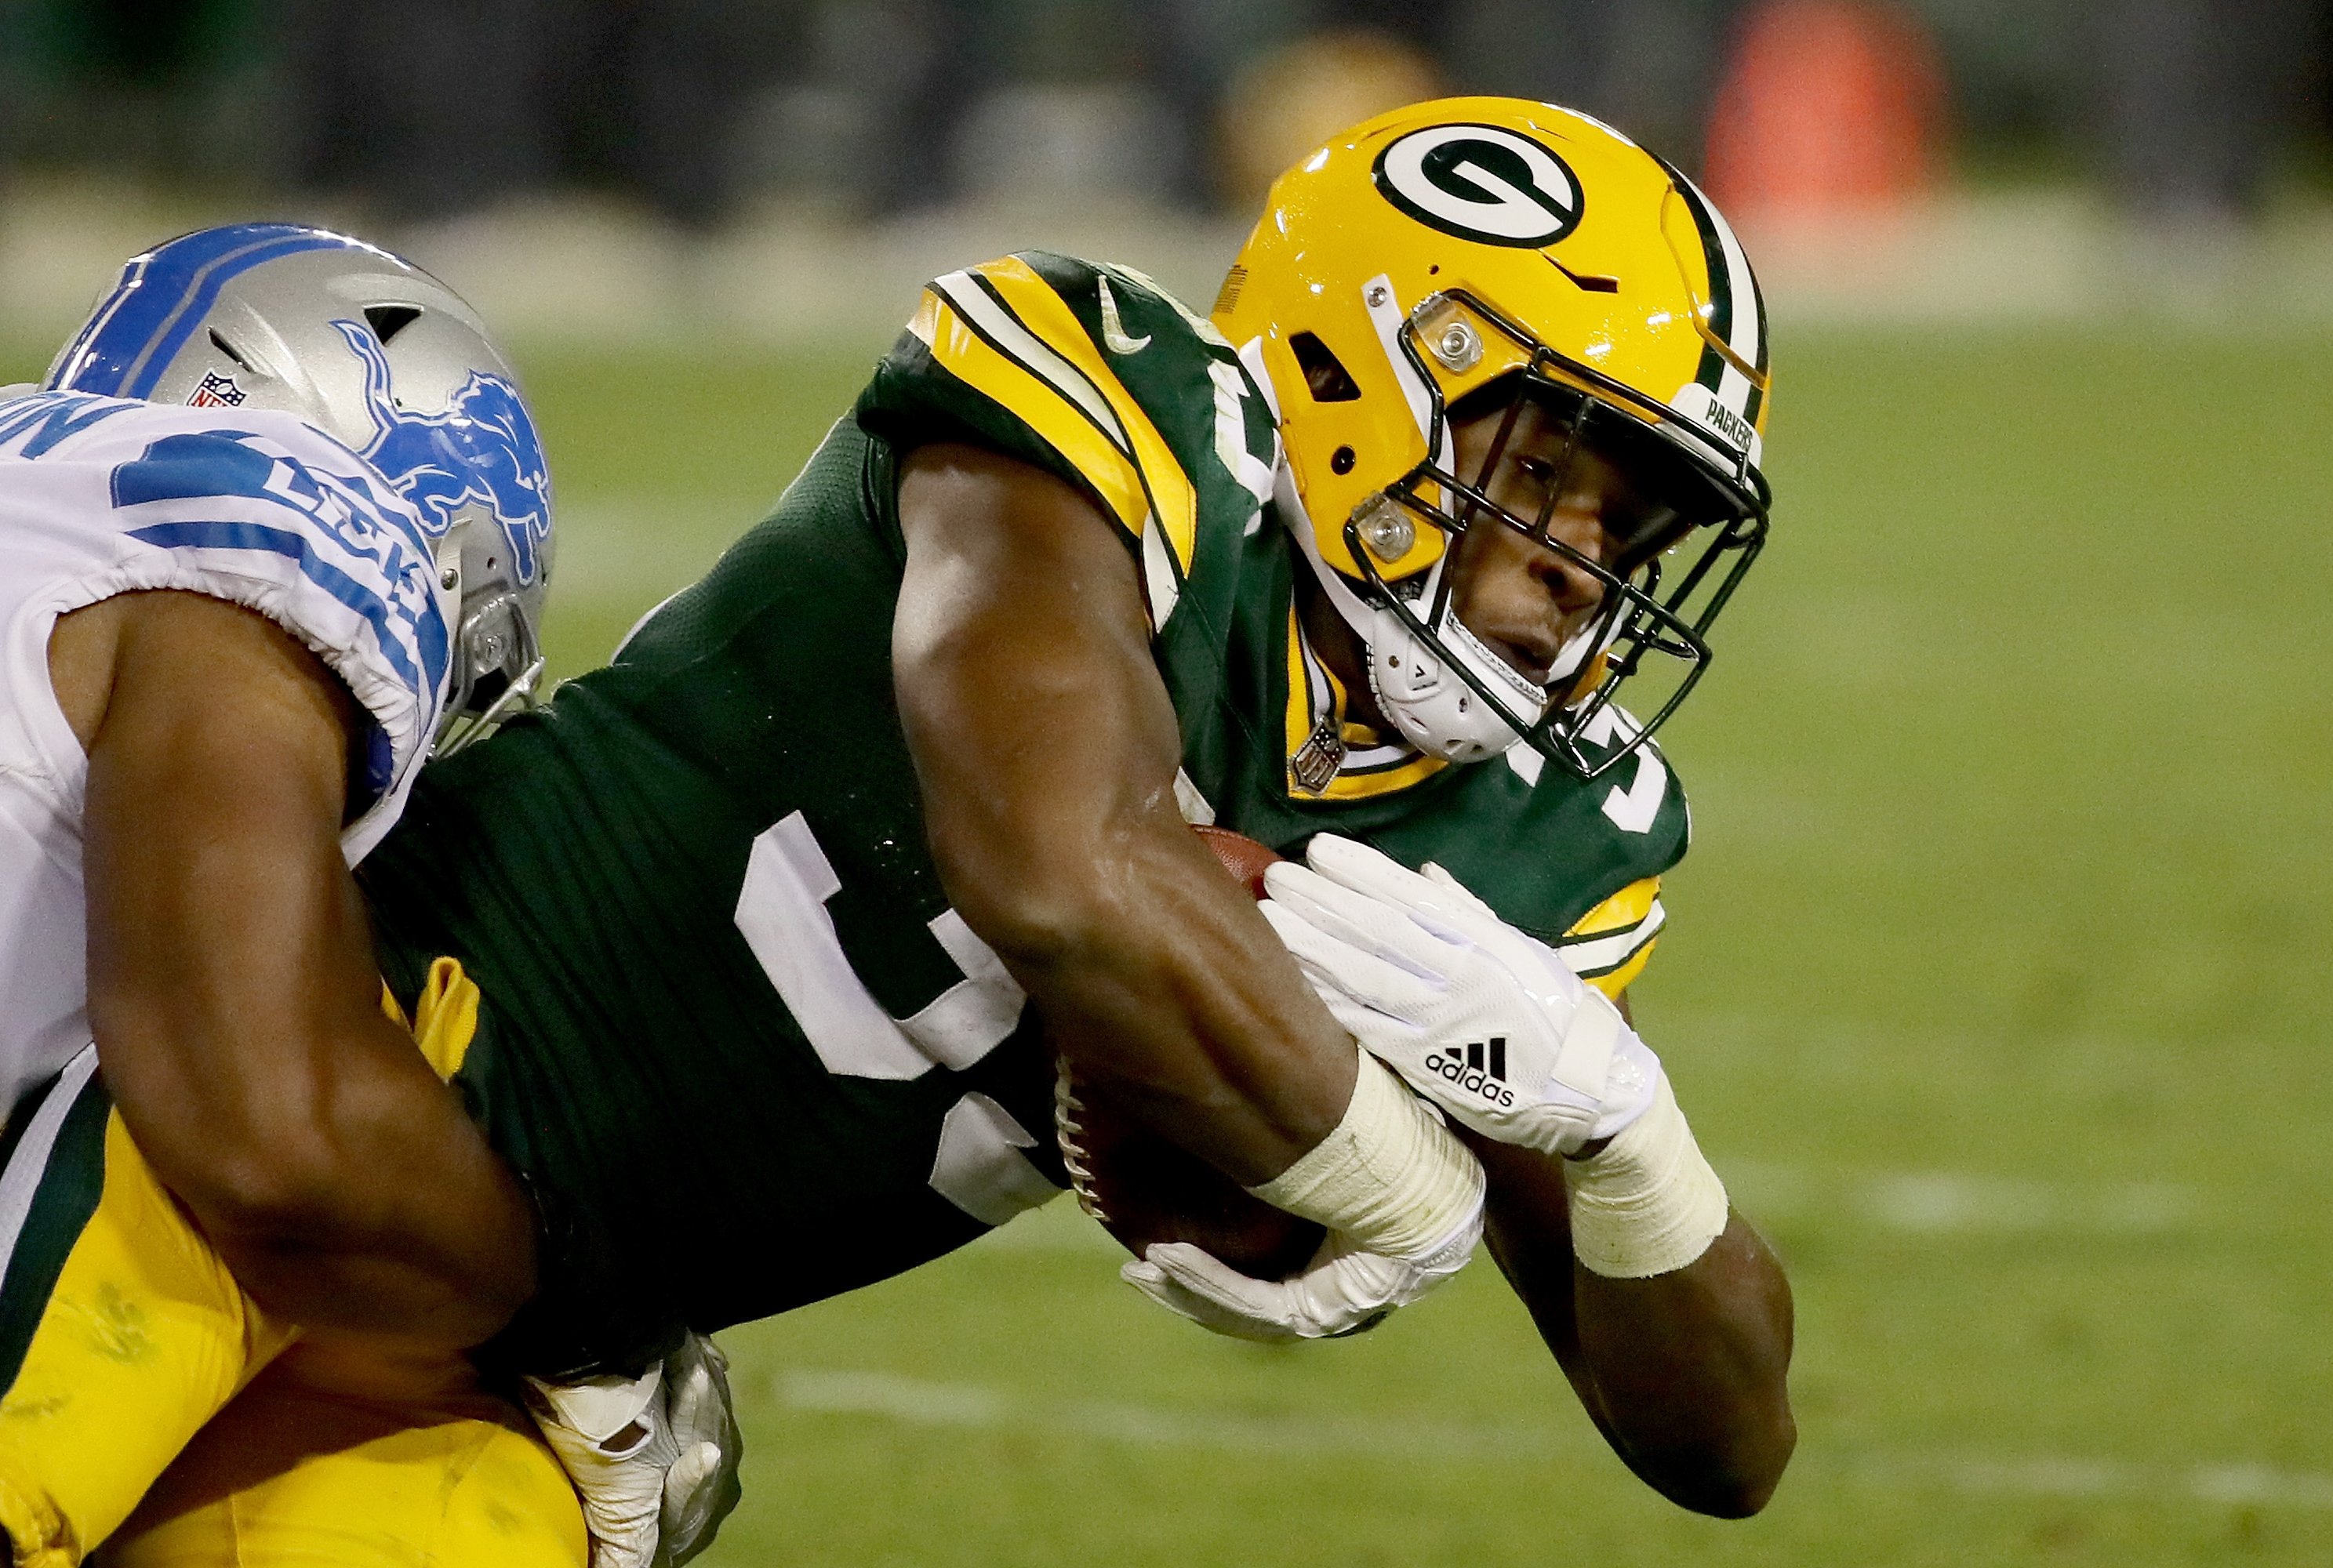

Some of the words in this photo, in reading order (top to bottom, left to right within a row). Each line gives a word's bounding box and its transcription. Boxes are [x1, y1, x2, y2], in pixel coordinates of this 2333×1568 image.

[1382, 125, 1575, 240] G
[1706, 397, 1753, 453] PACKERS
[1426, 1054, 1515, 1107] adidas
